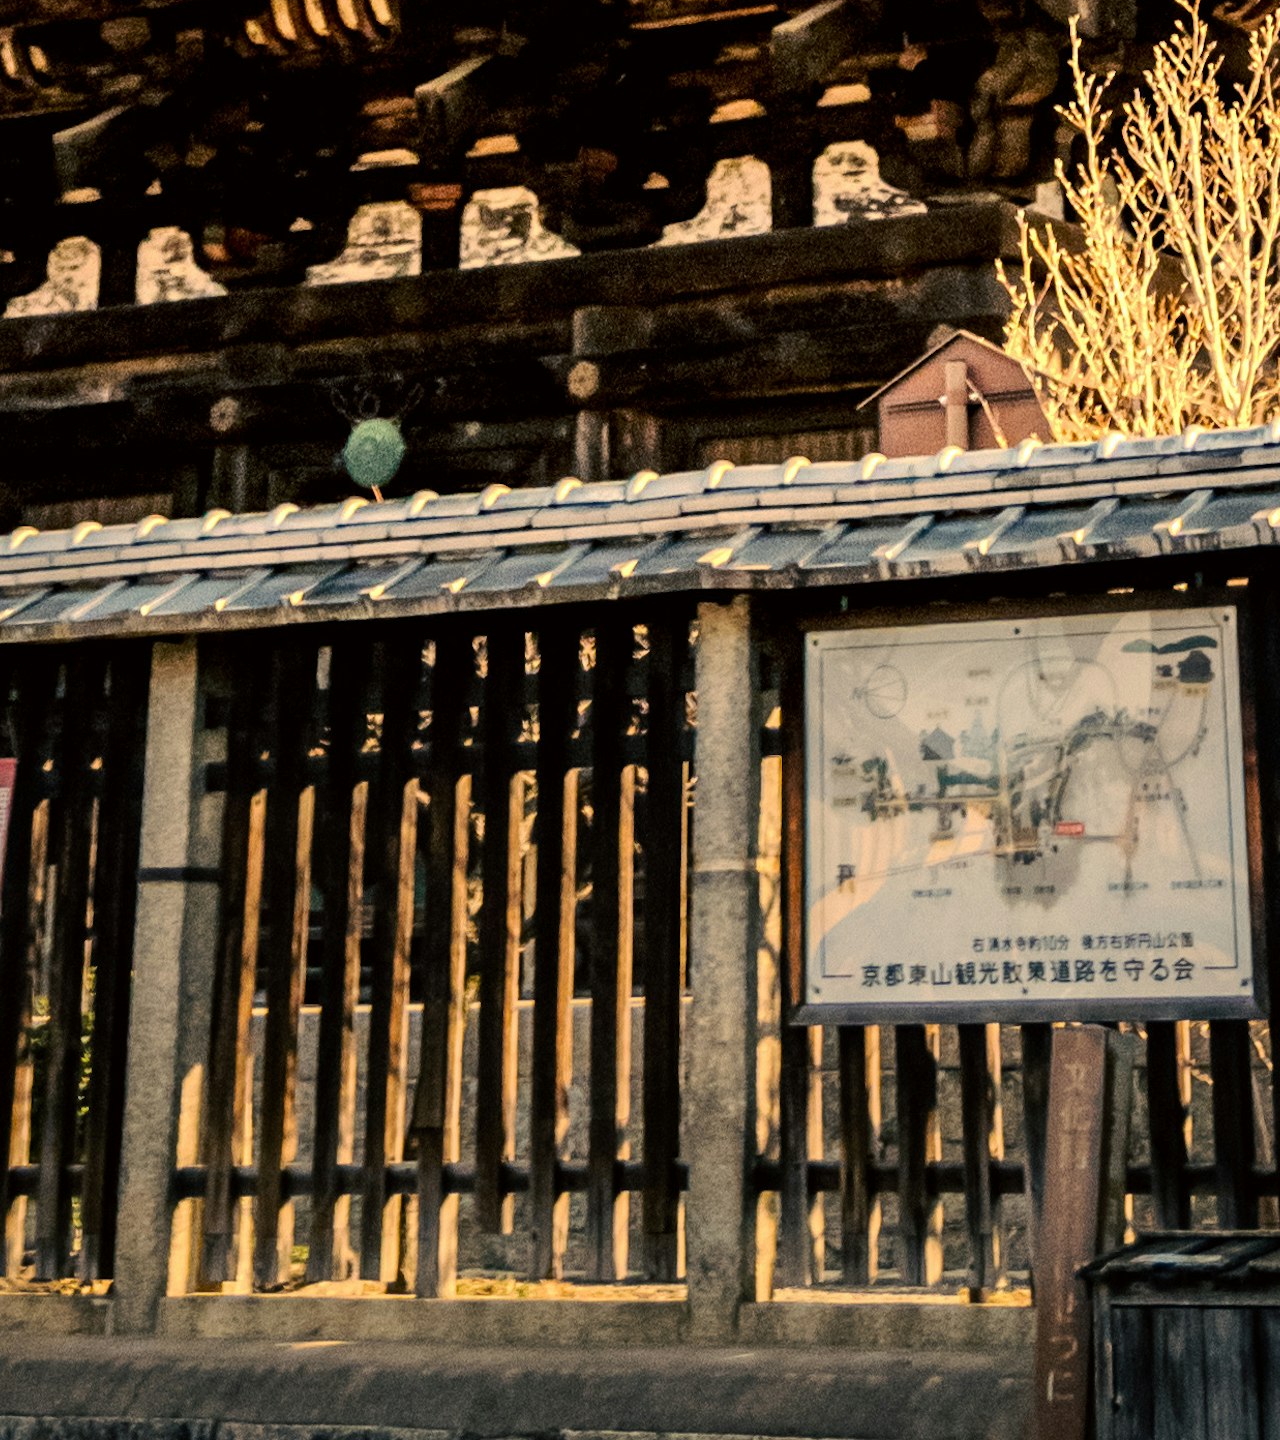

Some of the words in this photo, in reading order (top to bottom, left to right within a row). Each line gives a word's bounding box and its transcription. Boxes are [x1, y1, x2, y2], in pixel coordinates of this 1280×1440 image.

[860, 956, 1197, 988] 京都東山観光散策道路を守る会
